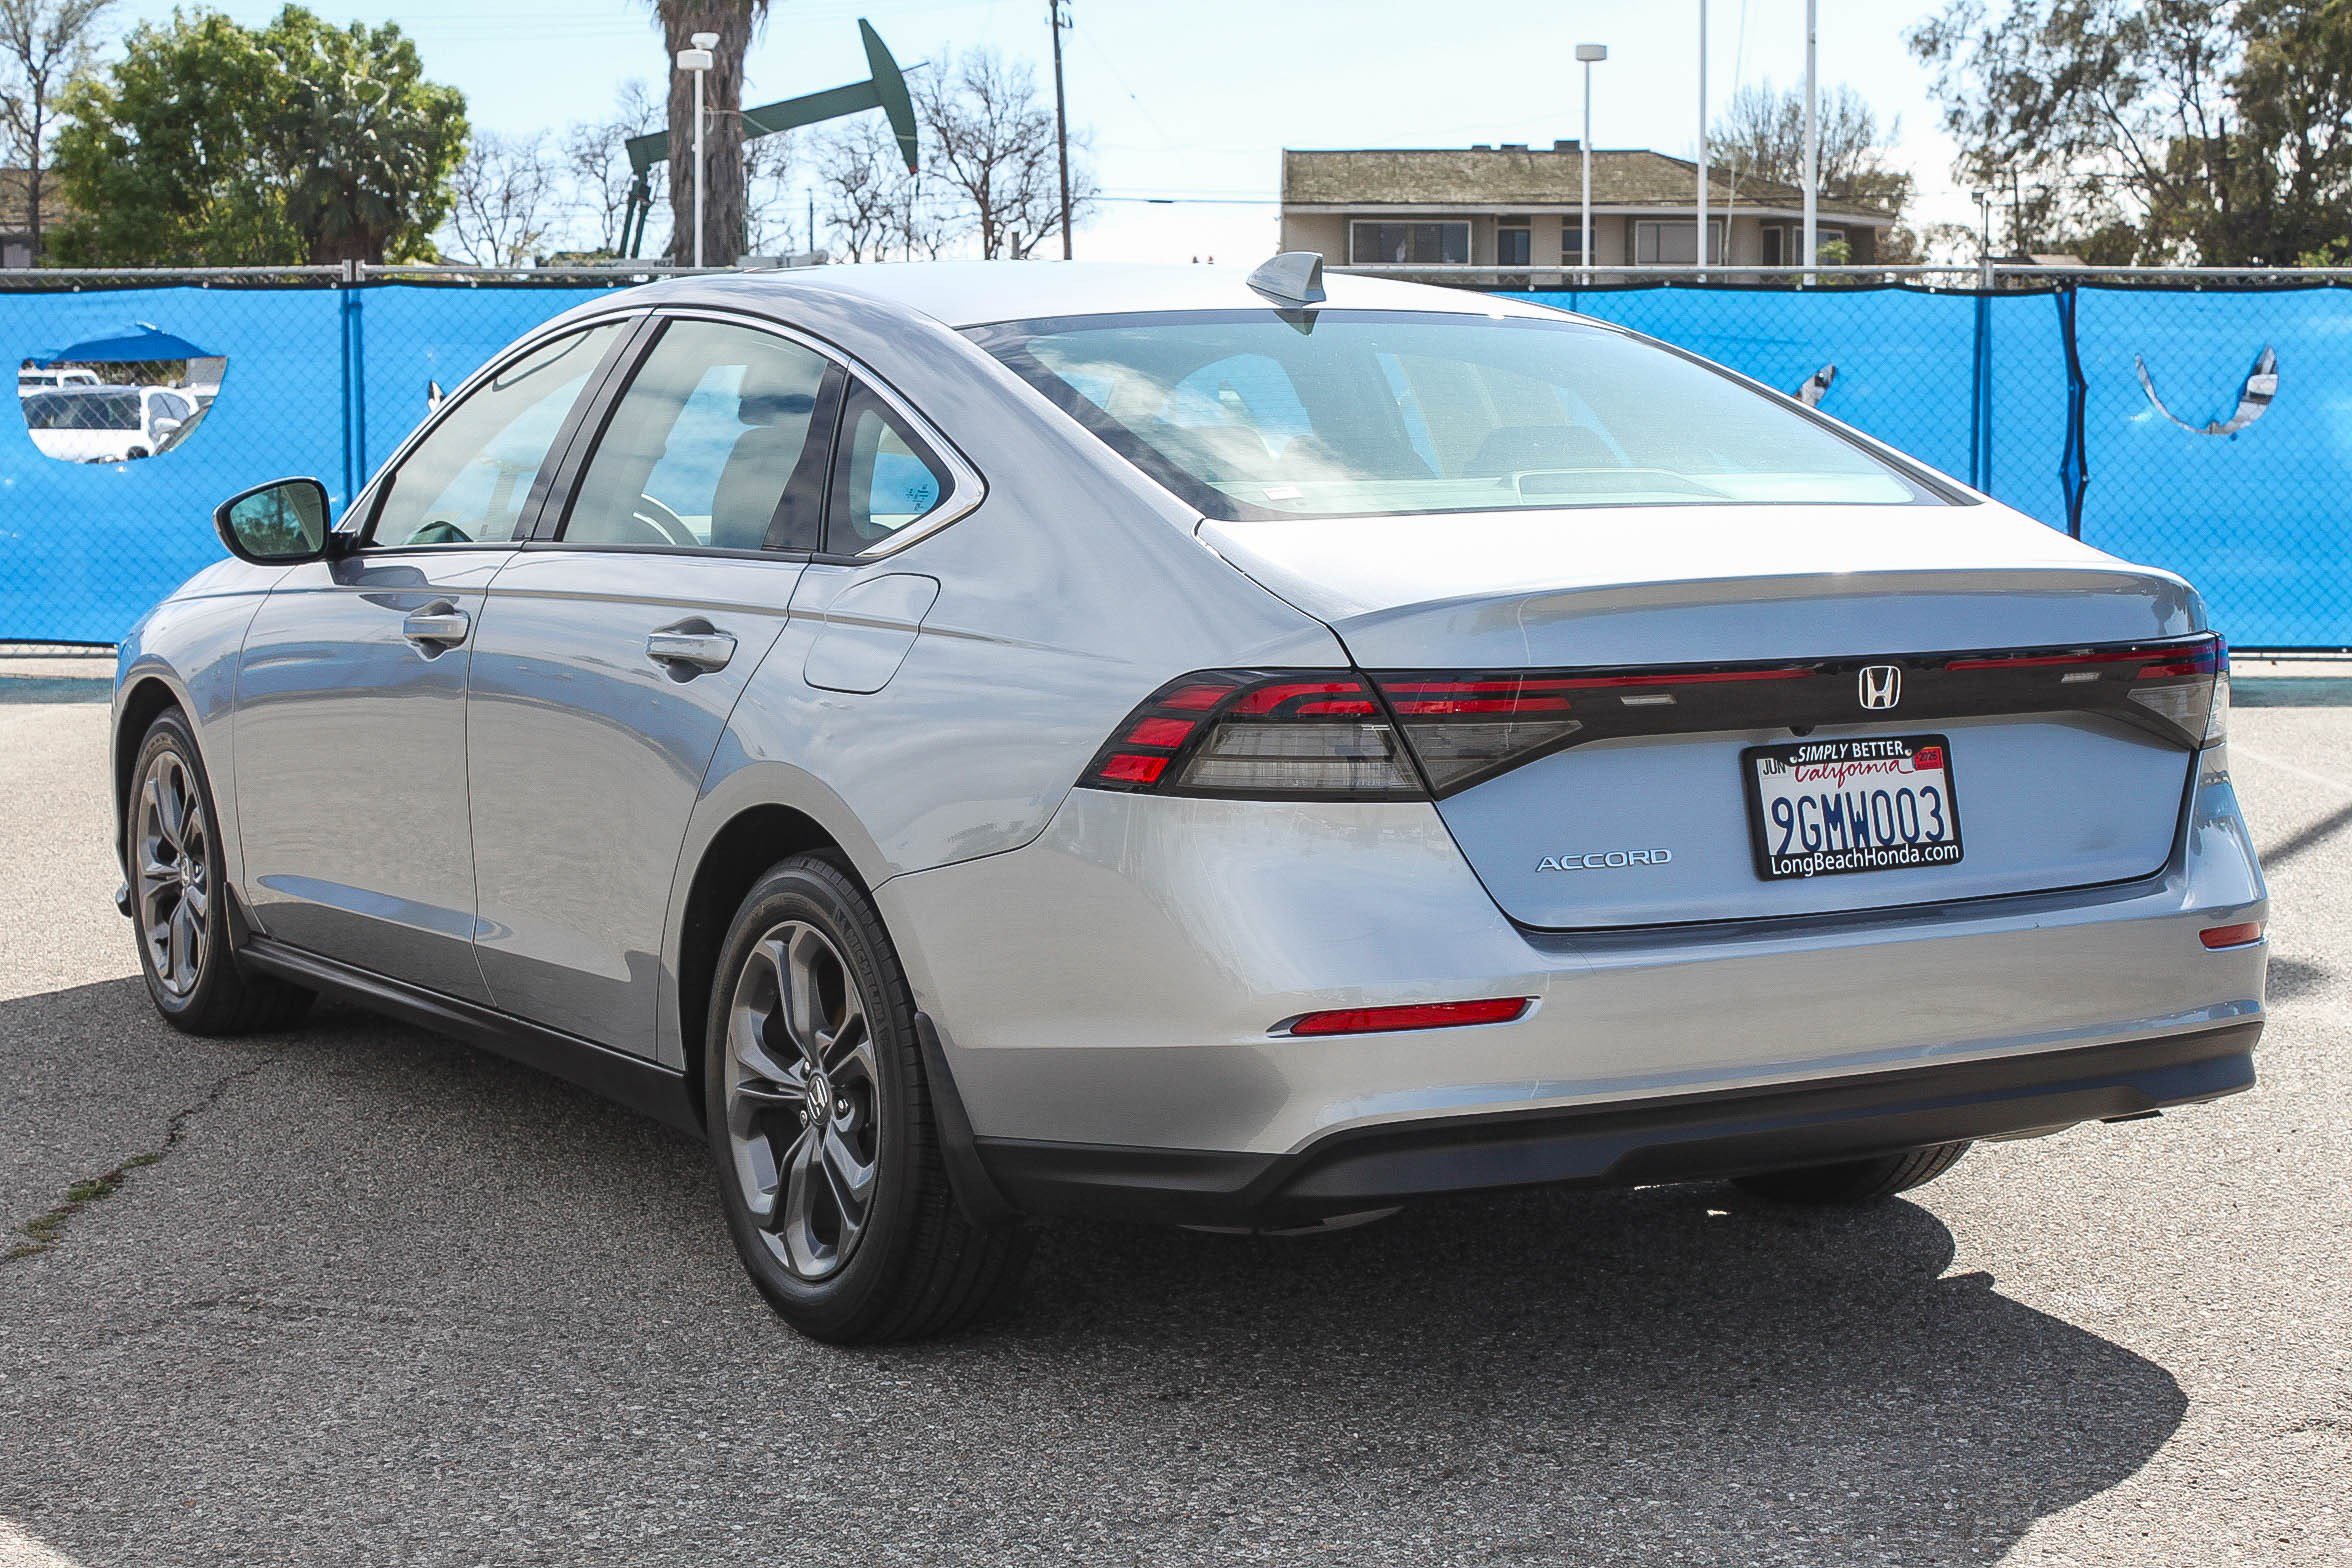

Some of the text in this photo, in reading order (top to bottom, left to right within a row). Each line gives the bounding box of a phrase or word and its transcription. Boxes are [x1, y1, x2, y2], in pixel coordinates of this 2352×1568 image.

[1798, 740, 1904, 763] SIMPLY BETTER
[1762, 758, 1787, 776] JUN
[1794, 758, 1913, 788] California
[1771, 785, 1945, 855] 9GMW003
[1535, 848, 1673, 872] ACCORD
[1771, 844, 1959, 877] LongBeachHonda.com
